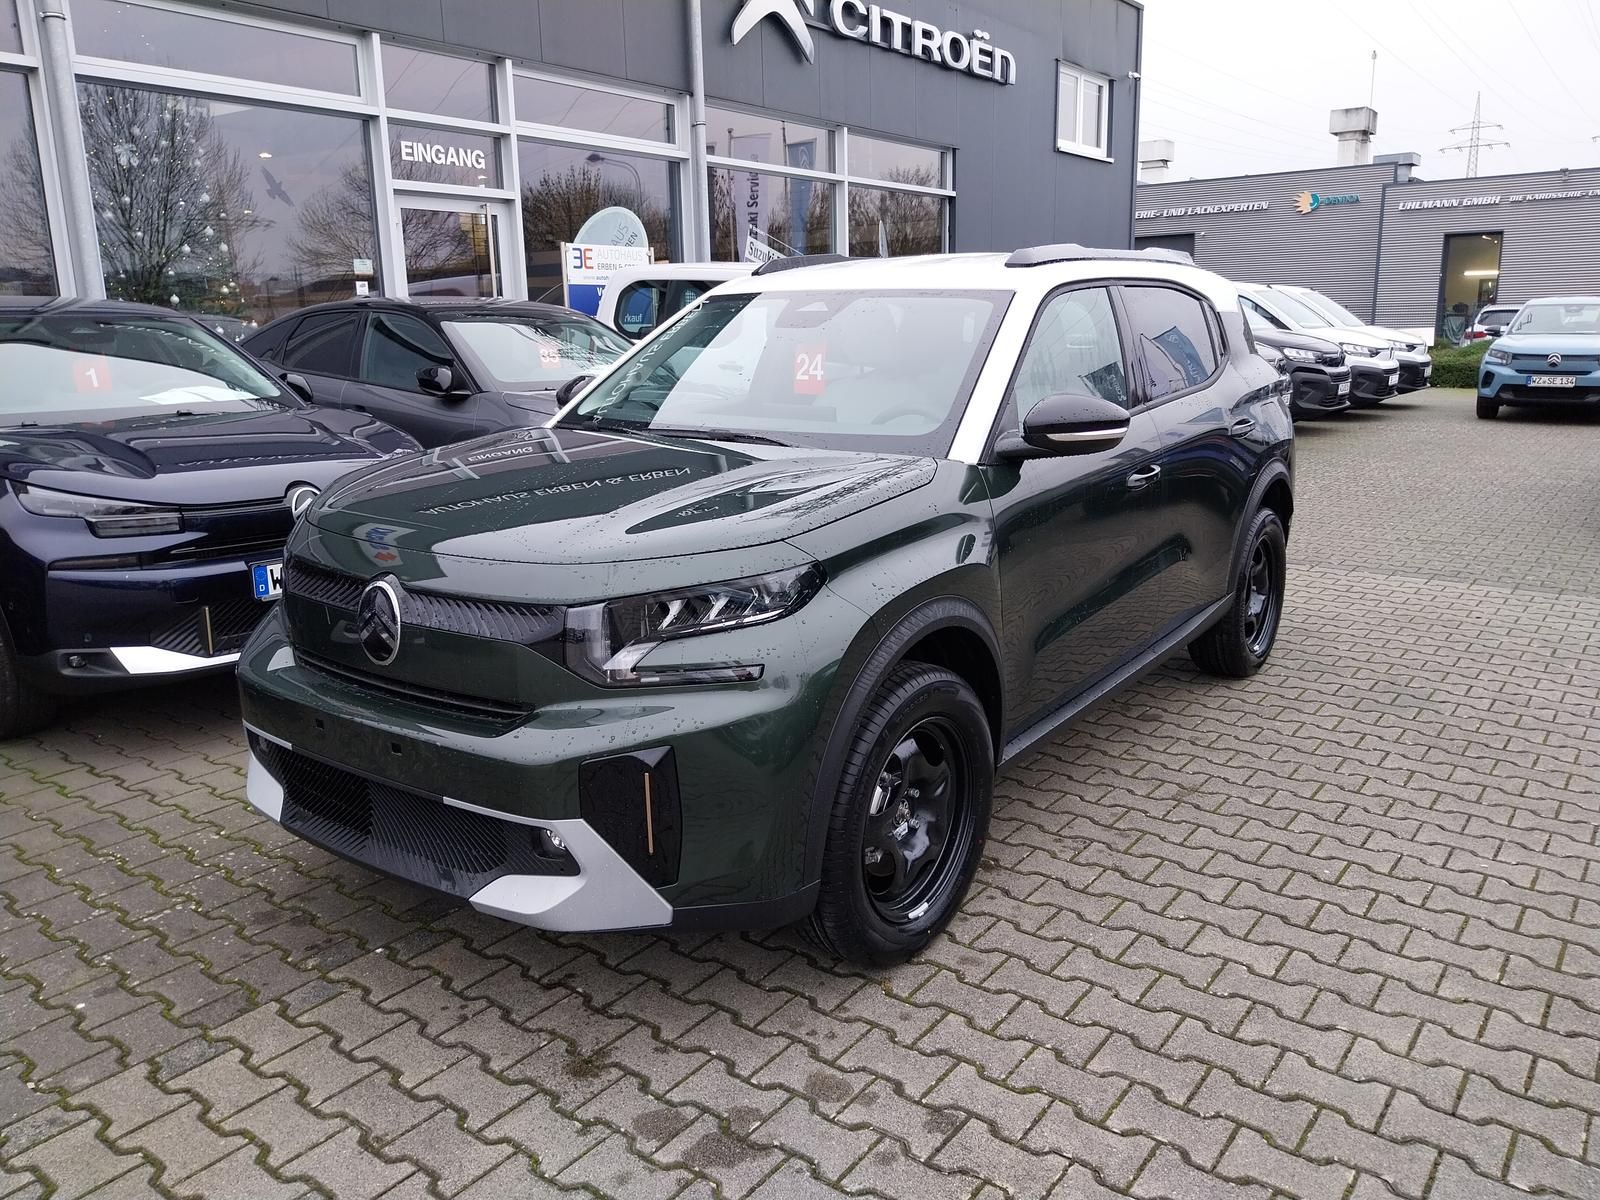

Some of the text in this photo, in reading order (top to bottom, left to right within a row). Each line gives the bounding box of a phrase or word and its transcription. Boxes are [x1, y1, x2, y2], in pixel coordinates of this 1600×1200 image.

[400, 140, 486, 169] EINGANG
[1135, 200, 1270, 220] ERIE- UND LACKEXPERTEN
[1398, 199, 1459, 211] UHLMANN
[1462, 196, 1500, 206] GMBH
[596, 247, 644, 262] AUTOHAUS
[624, 313, 643, 323] rkauf
[796, 352, 824, 381] 24
[85, 367, 99, 388] 1
[1547, 377, 1558, 385] SE
[1560, 377, 1575, 385] 134
